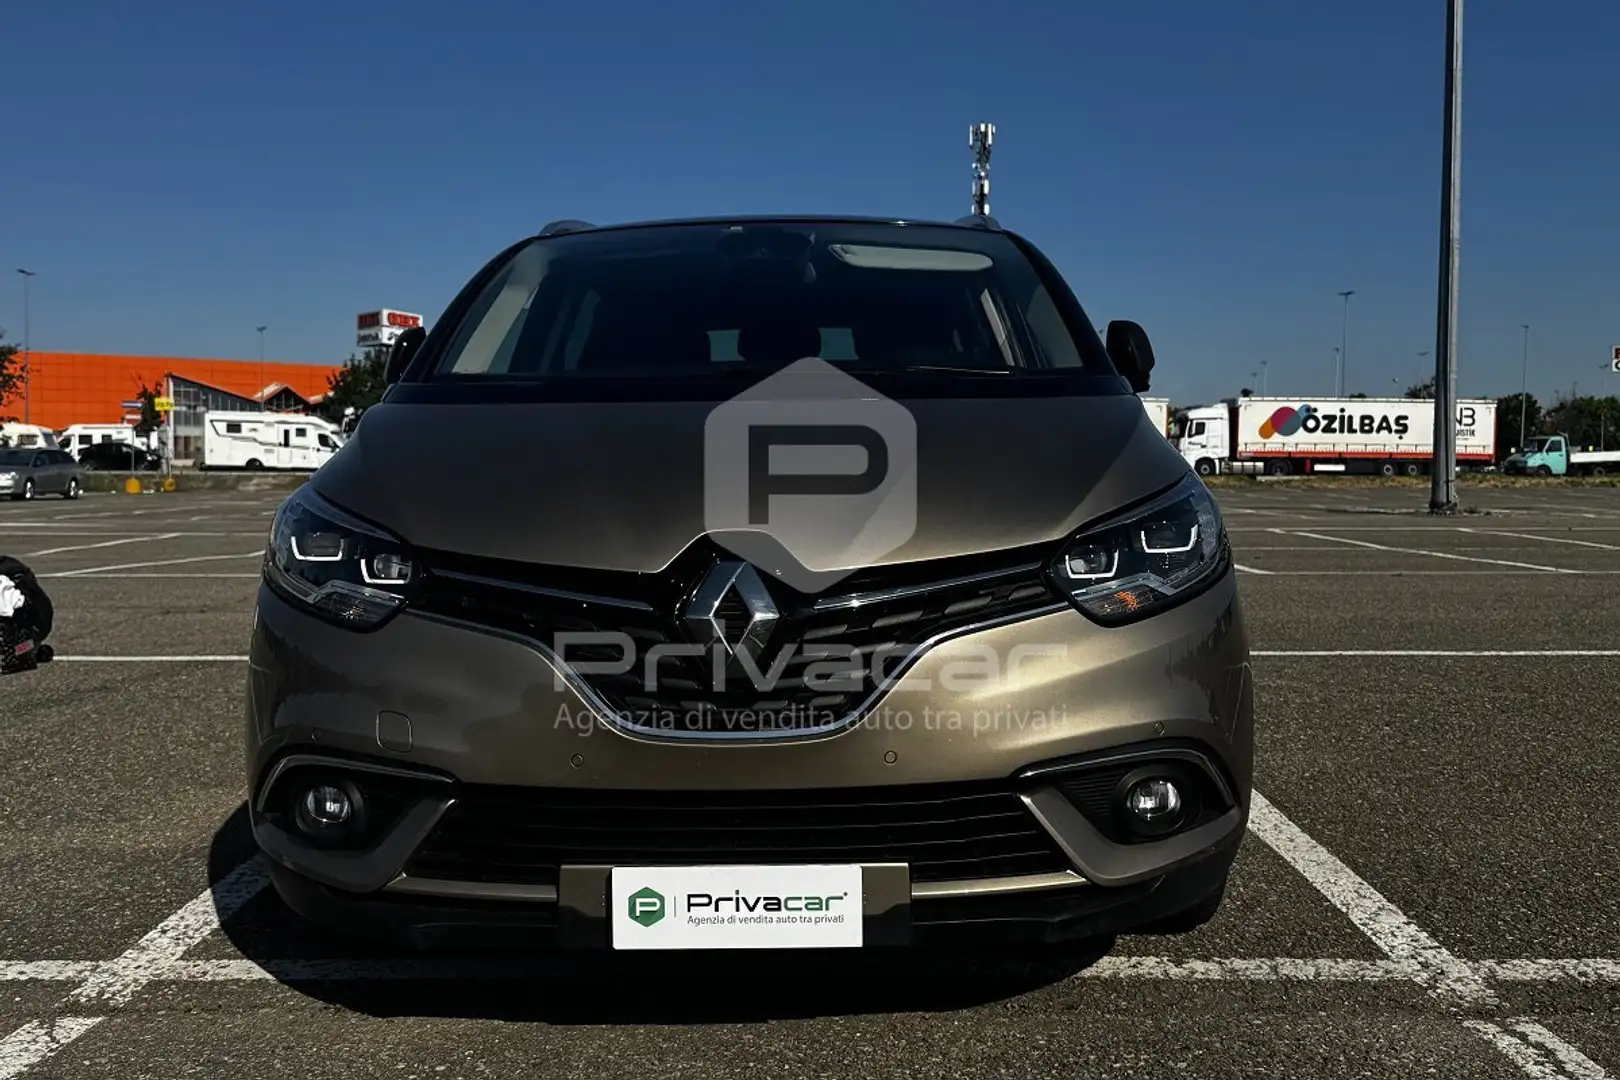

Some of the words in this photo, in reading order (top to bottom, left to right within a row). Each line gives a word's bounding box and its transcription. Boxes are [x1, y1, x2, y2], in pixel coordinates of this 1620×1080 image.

[1301, 407, 1409, 440] ÖZİLBAŞ
[687, 914, 725, 927] Agenzia
[727, 914, 737, 925] di
[738, 914, 774, 925] vendita
[775, 915, 798, 924] auto
[799, 915, 813, 924] tra
[814, 914, 844, 926] privati
